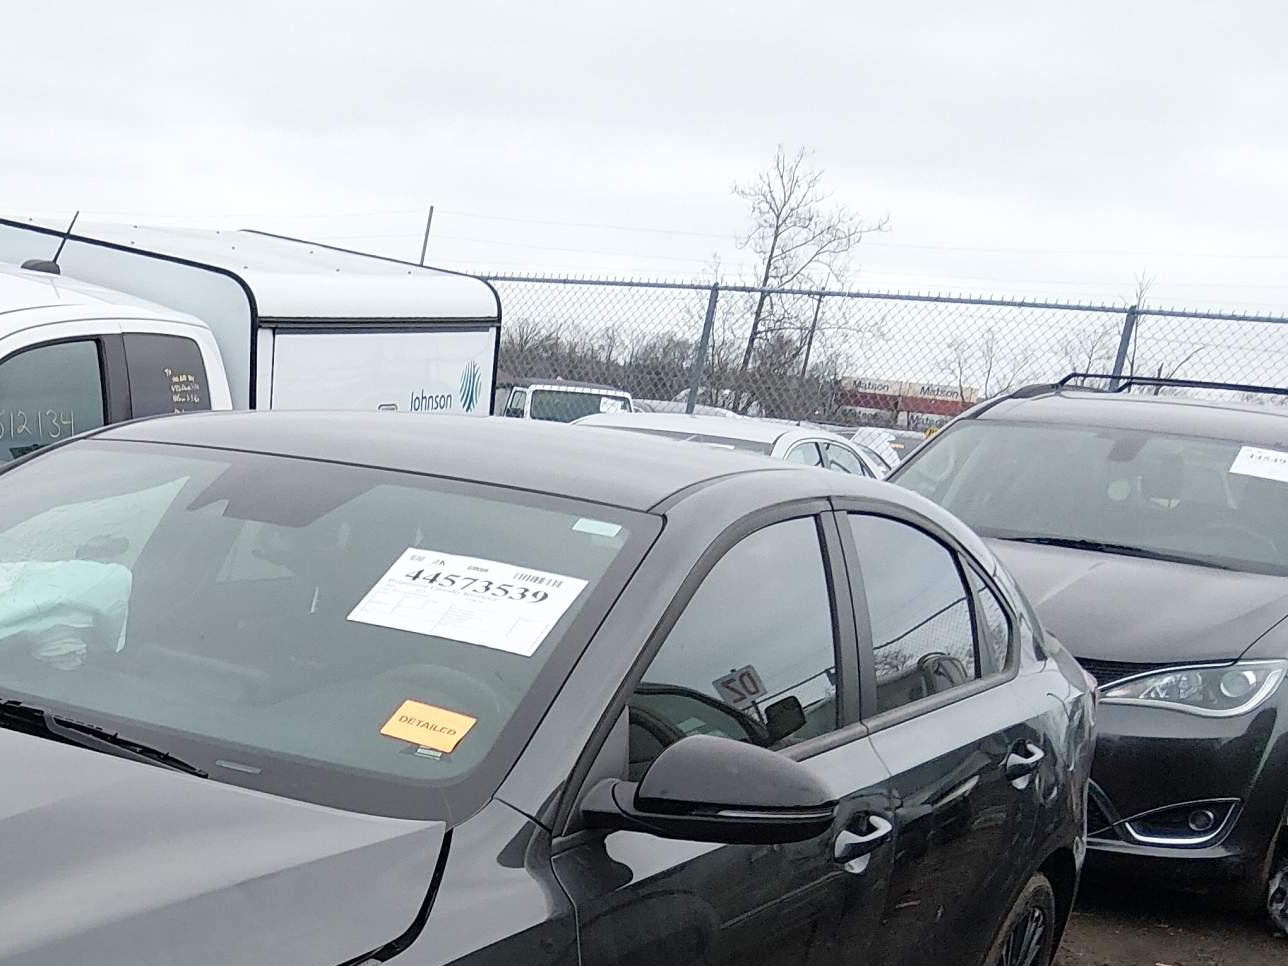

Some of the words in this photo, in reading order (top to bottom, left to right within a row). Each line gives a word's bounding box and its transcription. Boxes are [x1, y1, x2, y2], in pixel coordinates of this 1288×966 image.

[853, 380, 889, 392] Matson
[919, 386, 960, 399] Matson
[410, 389, 453, 411] Johnson
[405, 567, 549, 605] 44573539
[398, 714, 457, 737] DETAILED
